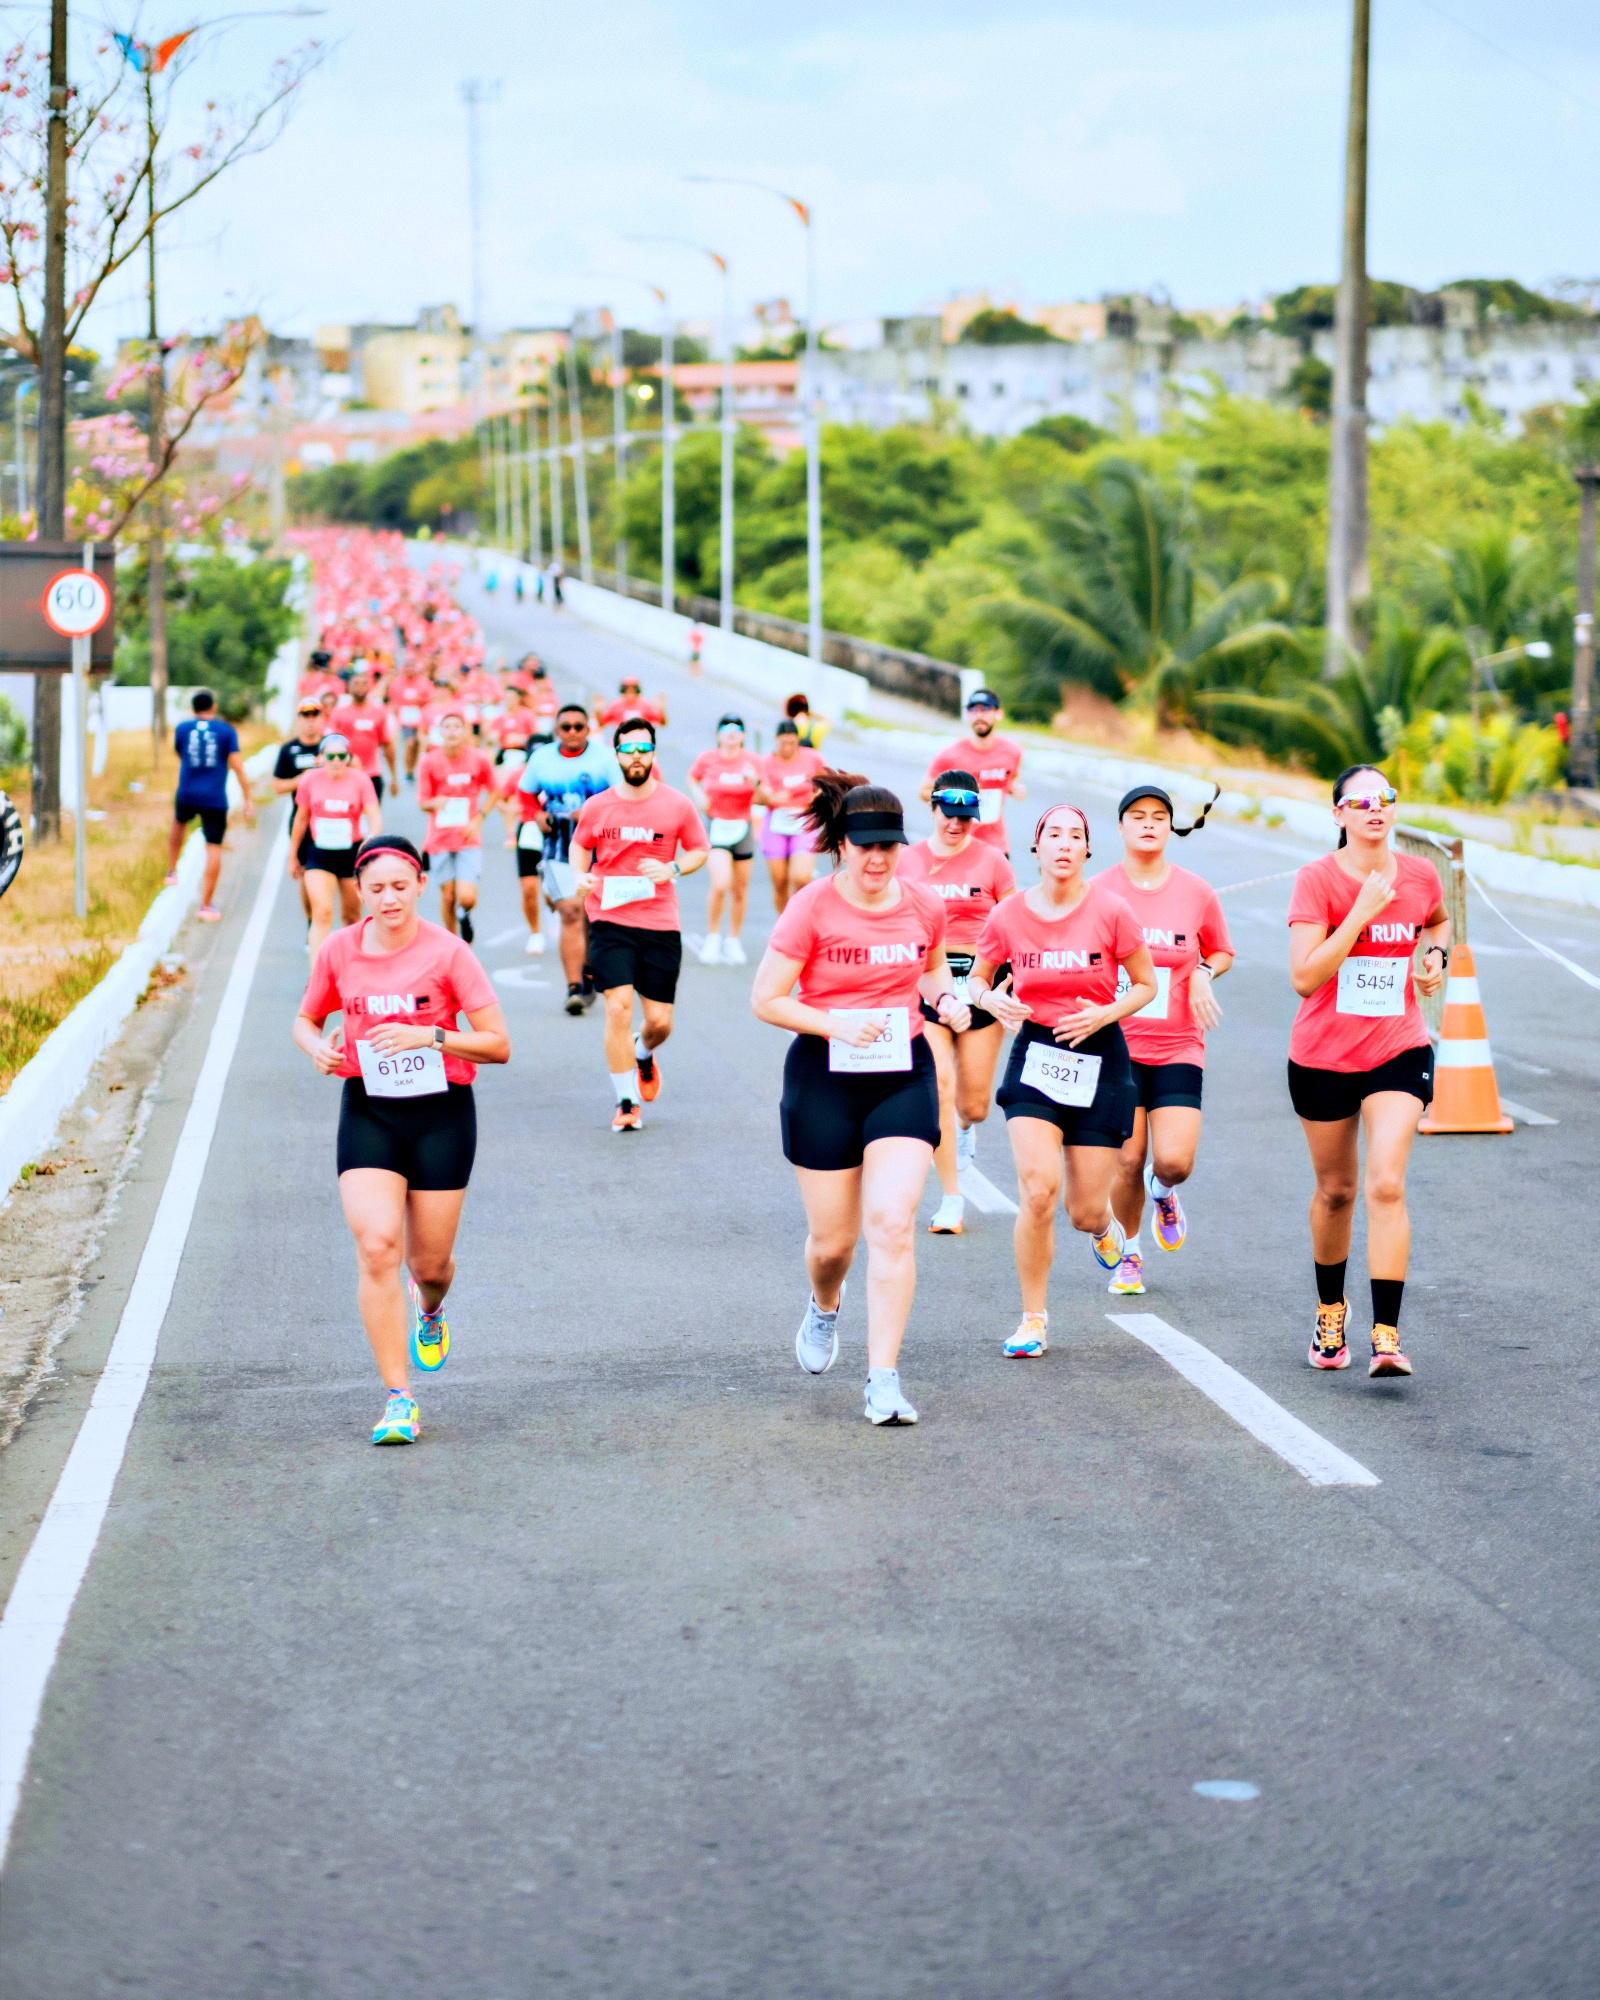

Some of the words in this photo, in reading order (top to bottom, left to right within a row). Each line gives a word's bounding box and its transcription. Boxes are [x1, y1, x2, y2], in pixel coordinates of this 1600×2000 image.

[56, 583, 95, 611] 60
[1356, 973, 1394, 990] 5454
[378, 1055, 425, 1076] 6120
[849, 1052, 892, 1060] Claudiana
[1040, 1062, 1079, 1083] 5321
[394, 1078, 414, 1087] 5KM
